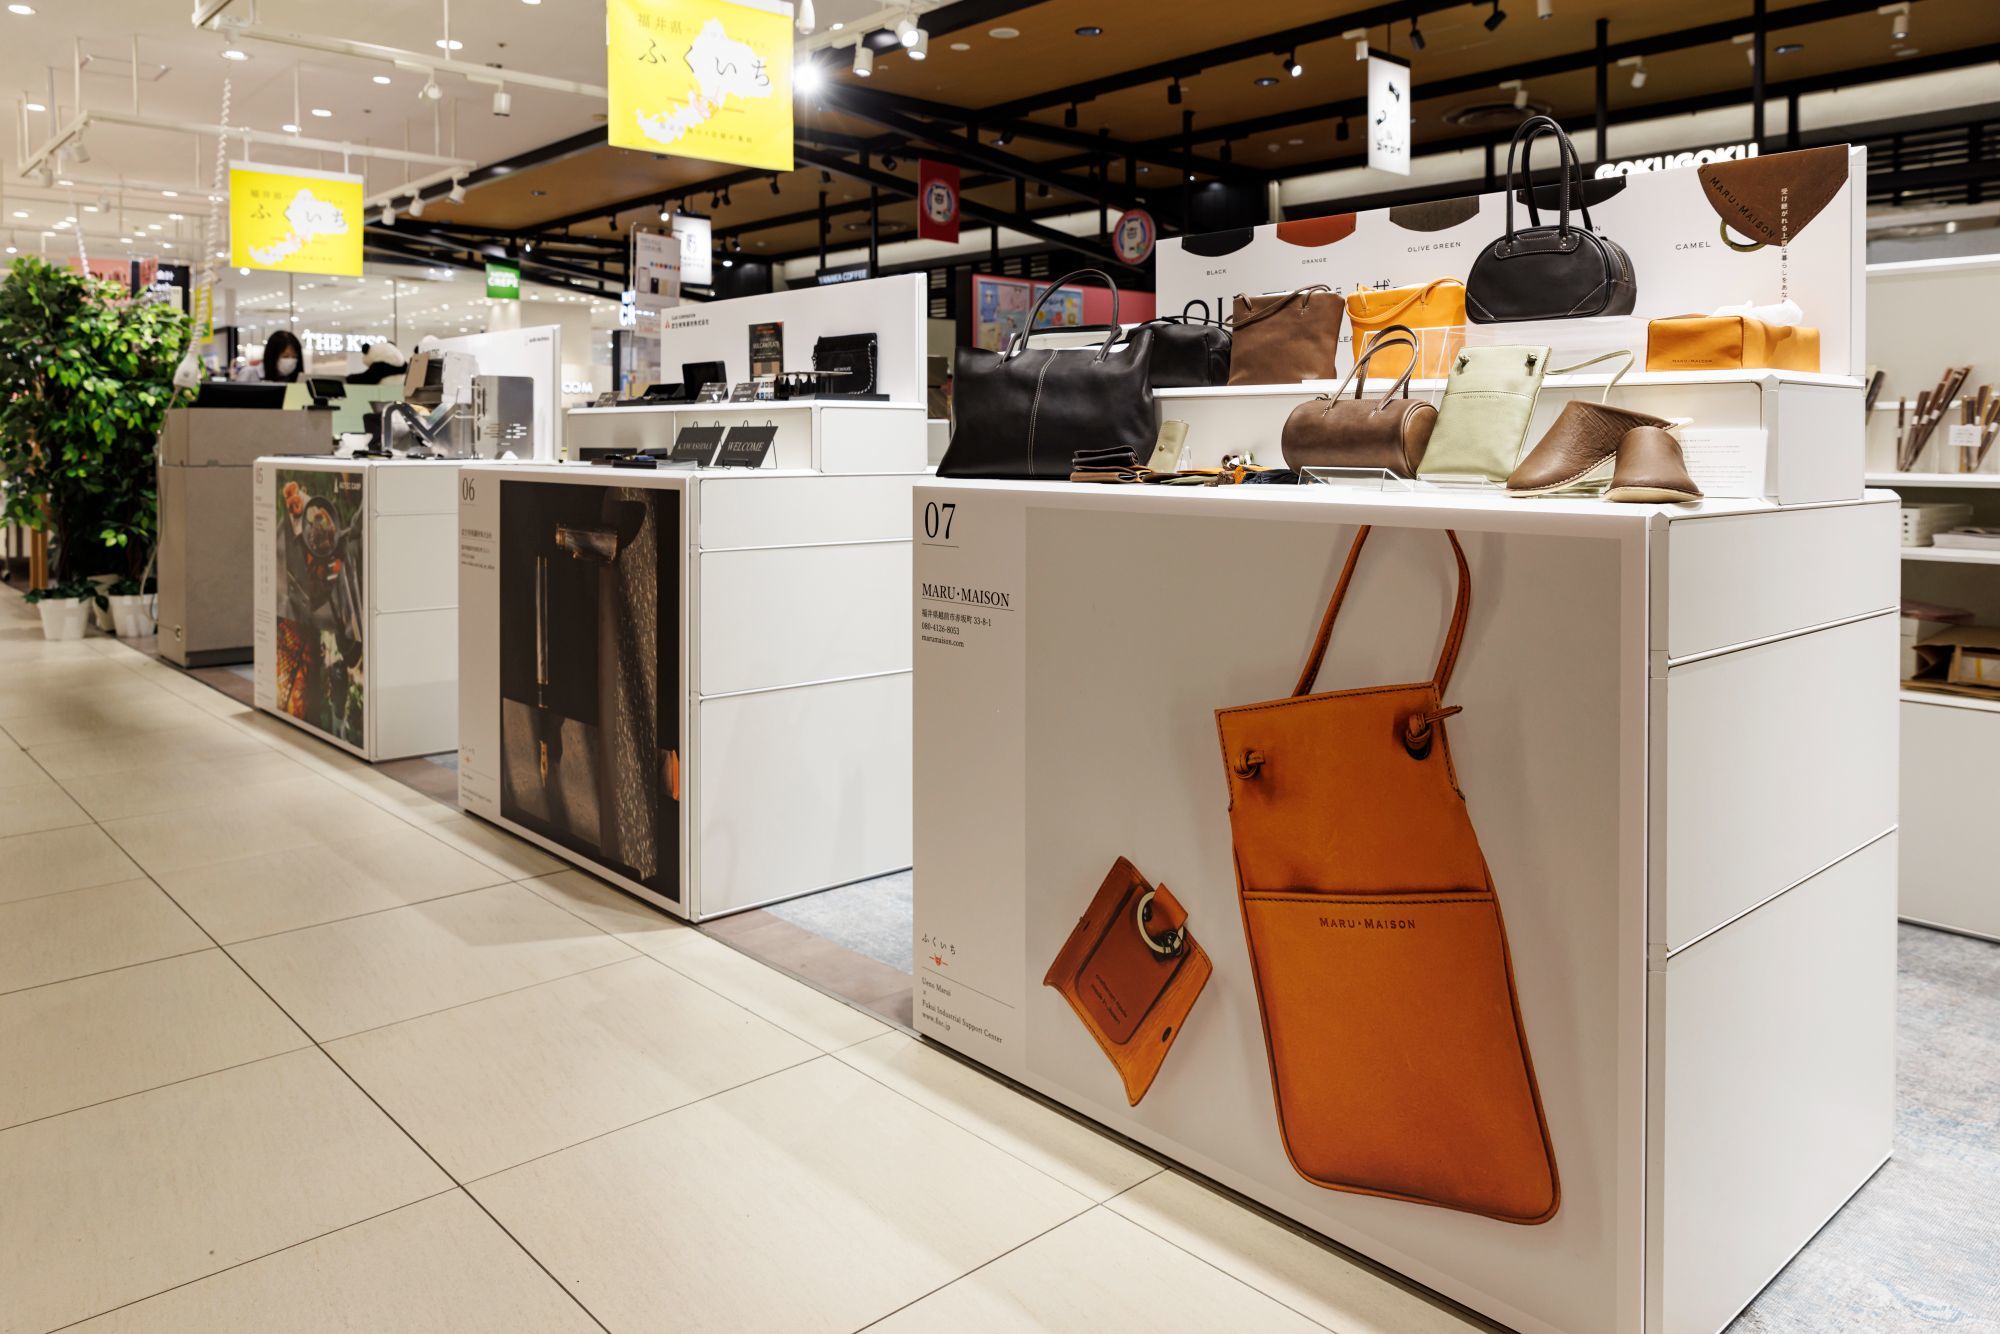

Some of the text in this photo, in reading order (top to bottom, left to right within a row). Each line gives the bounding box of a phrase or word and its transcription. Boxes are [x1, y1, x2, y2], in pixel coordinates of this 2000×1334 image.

[638, 38, 771, 87] ふくいち
[1407, 241, 1461, 253] OLIVE GREEN
[1675, 241, 1712, 251] CAMEL
[1301, 257, 1328, 265] ORANGE
[301, 331, 343, 352] THE
[726, 441, 765, 452] WELCOME
[462, 477, 476, 501] 06
[924, 502, 956, 540] 07
[973, 616, 992, 628] 33-8-1
[921, 635, 965, 648] marumaison.com
[921, 932, 956, 955] ふくいち
[921, 999, 1003, 1044] Fukui Industrial Support Center
